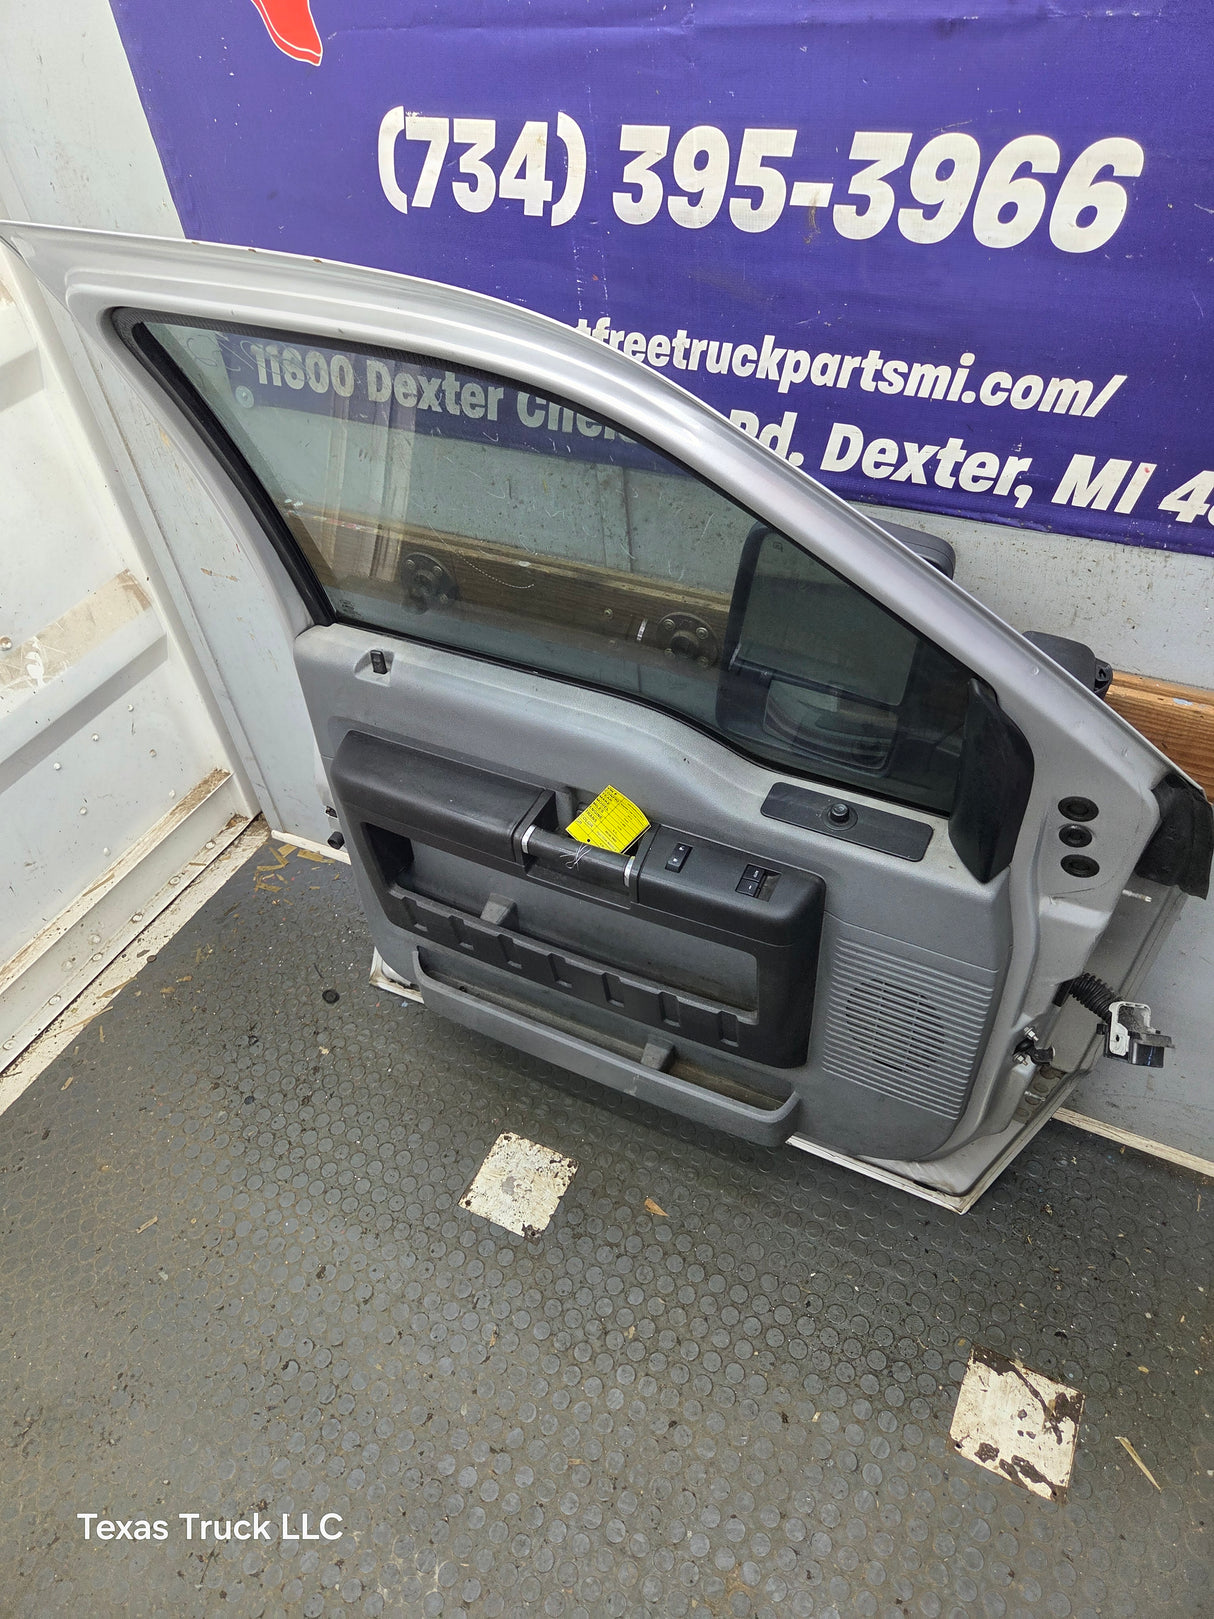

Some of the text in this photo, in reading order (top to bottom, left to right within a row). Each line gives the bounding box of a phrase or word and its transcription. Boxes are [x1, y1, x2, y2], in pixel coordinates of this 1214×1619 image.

[377, 105, 1145, 254] (734) 395-3966
[366, 359, 503, 421] Dexter
[819, 422, 1033, 509] Dexter,
[1050, 453, 1158, 515] MI
[1157, 470, 1214, 527] 4
